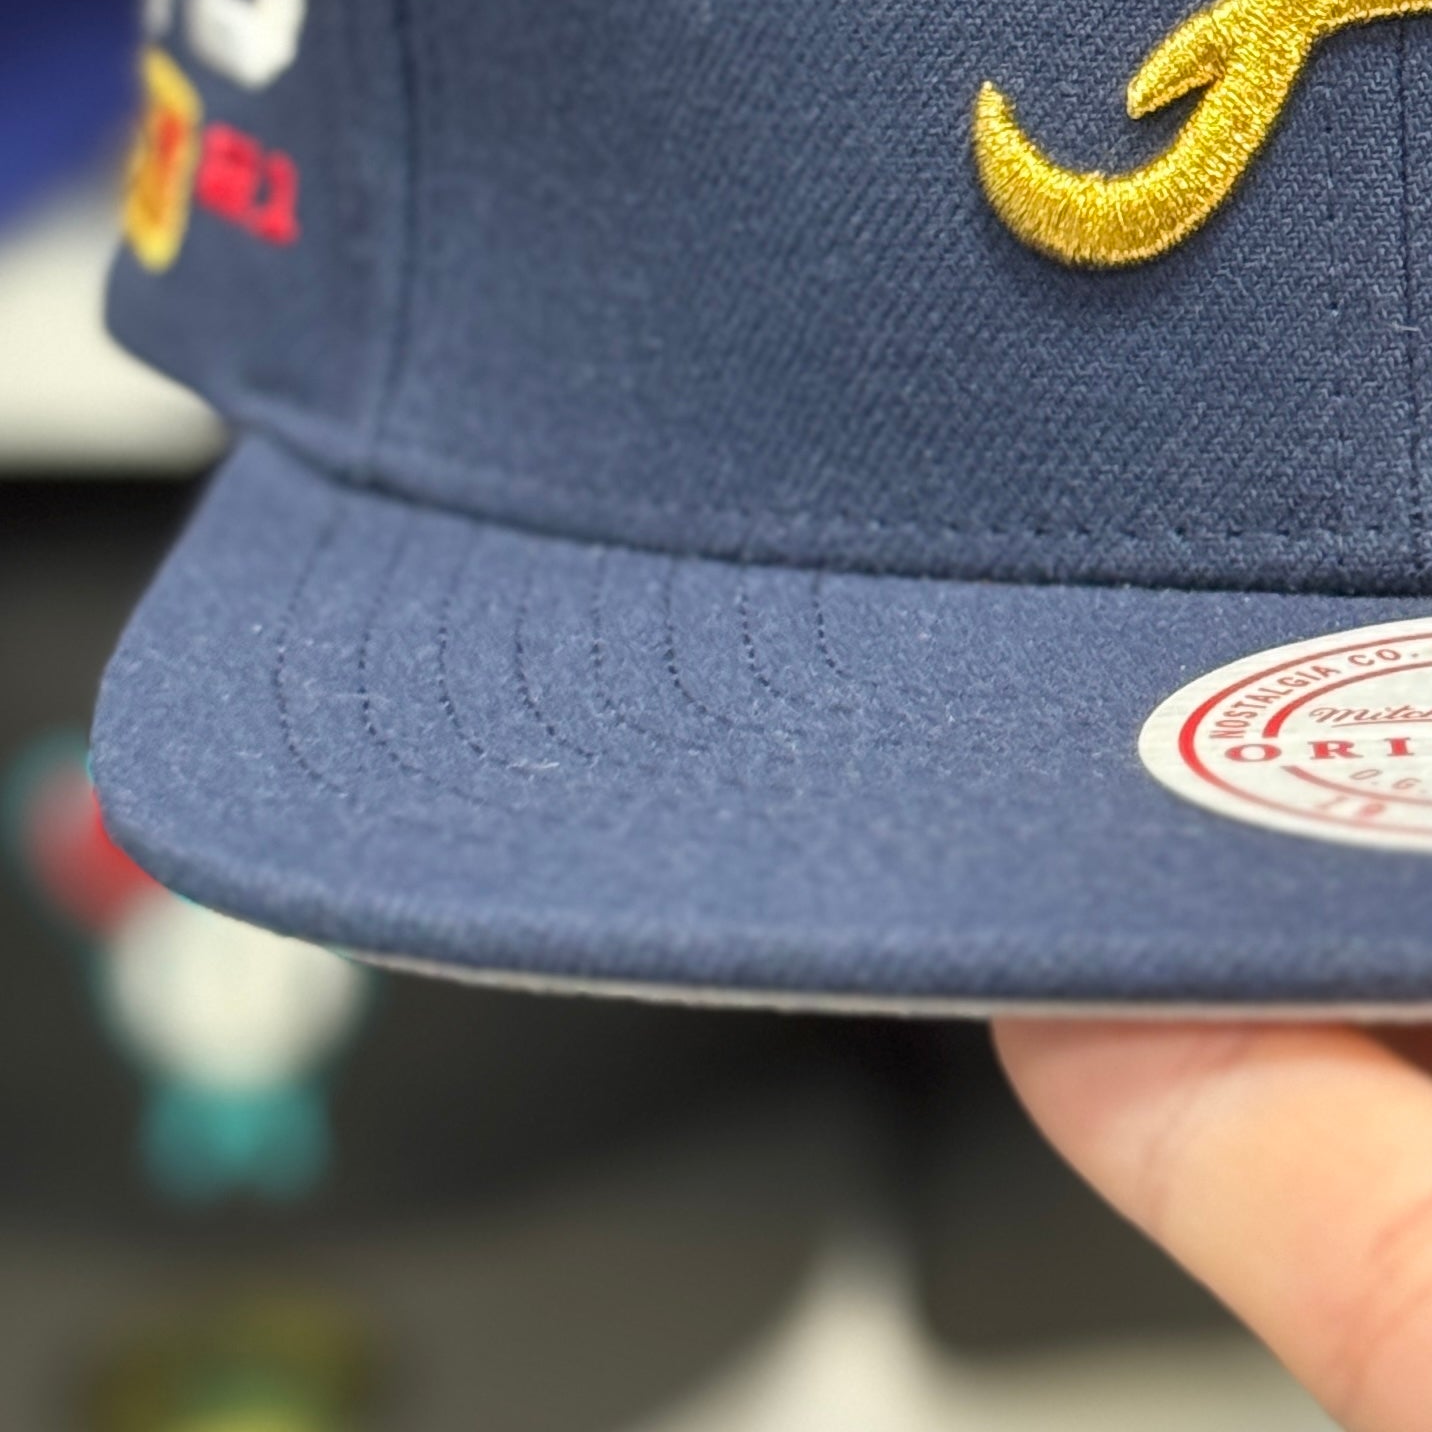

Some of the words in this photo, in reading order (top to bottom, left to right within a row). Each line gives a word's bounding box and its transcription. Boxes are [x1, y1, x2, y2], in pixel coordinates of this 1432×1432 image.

[1209, 664, 1342, 739] NOSTALGIA
[1347, 648, 1419, 667] CO.
[1348, 768, 1428, 795] O.G.
